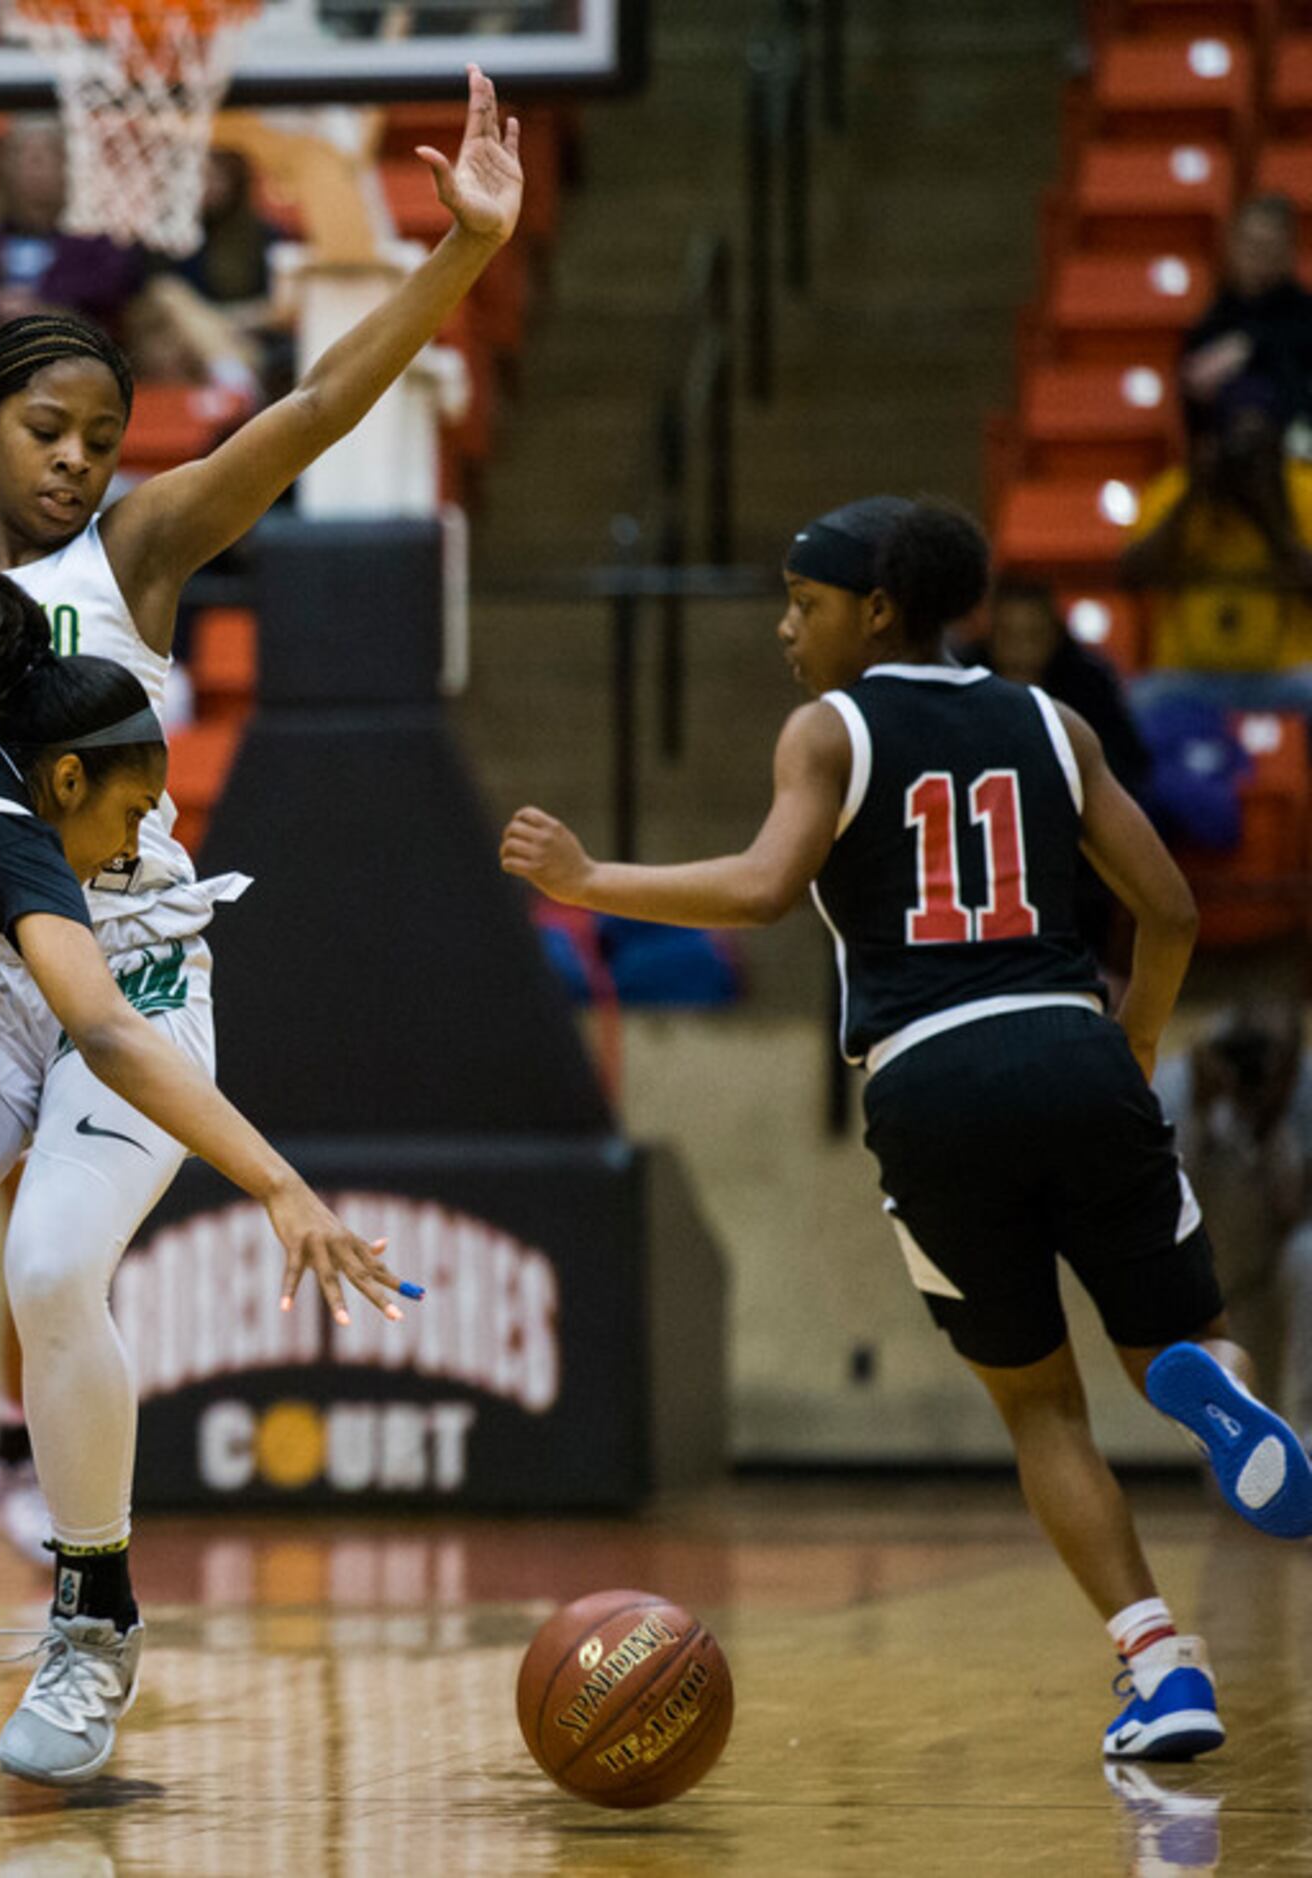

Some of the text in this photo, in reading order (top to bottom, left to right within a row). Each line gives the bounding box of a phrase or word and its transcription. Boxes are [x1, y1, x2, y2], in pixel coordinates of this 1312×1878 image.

[904, 768, 1039, 945] 11
[199, 1401, 475, 1491] COURT
[554, 1612, 680, 1745] SPALDING
[595, 1662, 710, 1773] TF-1000
